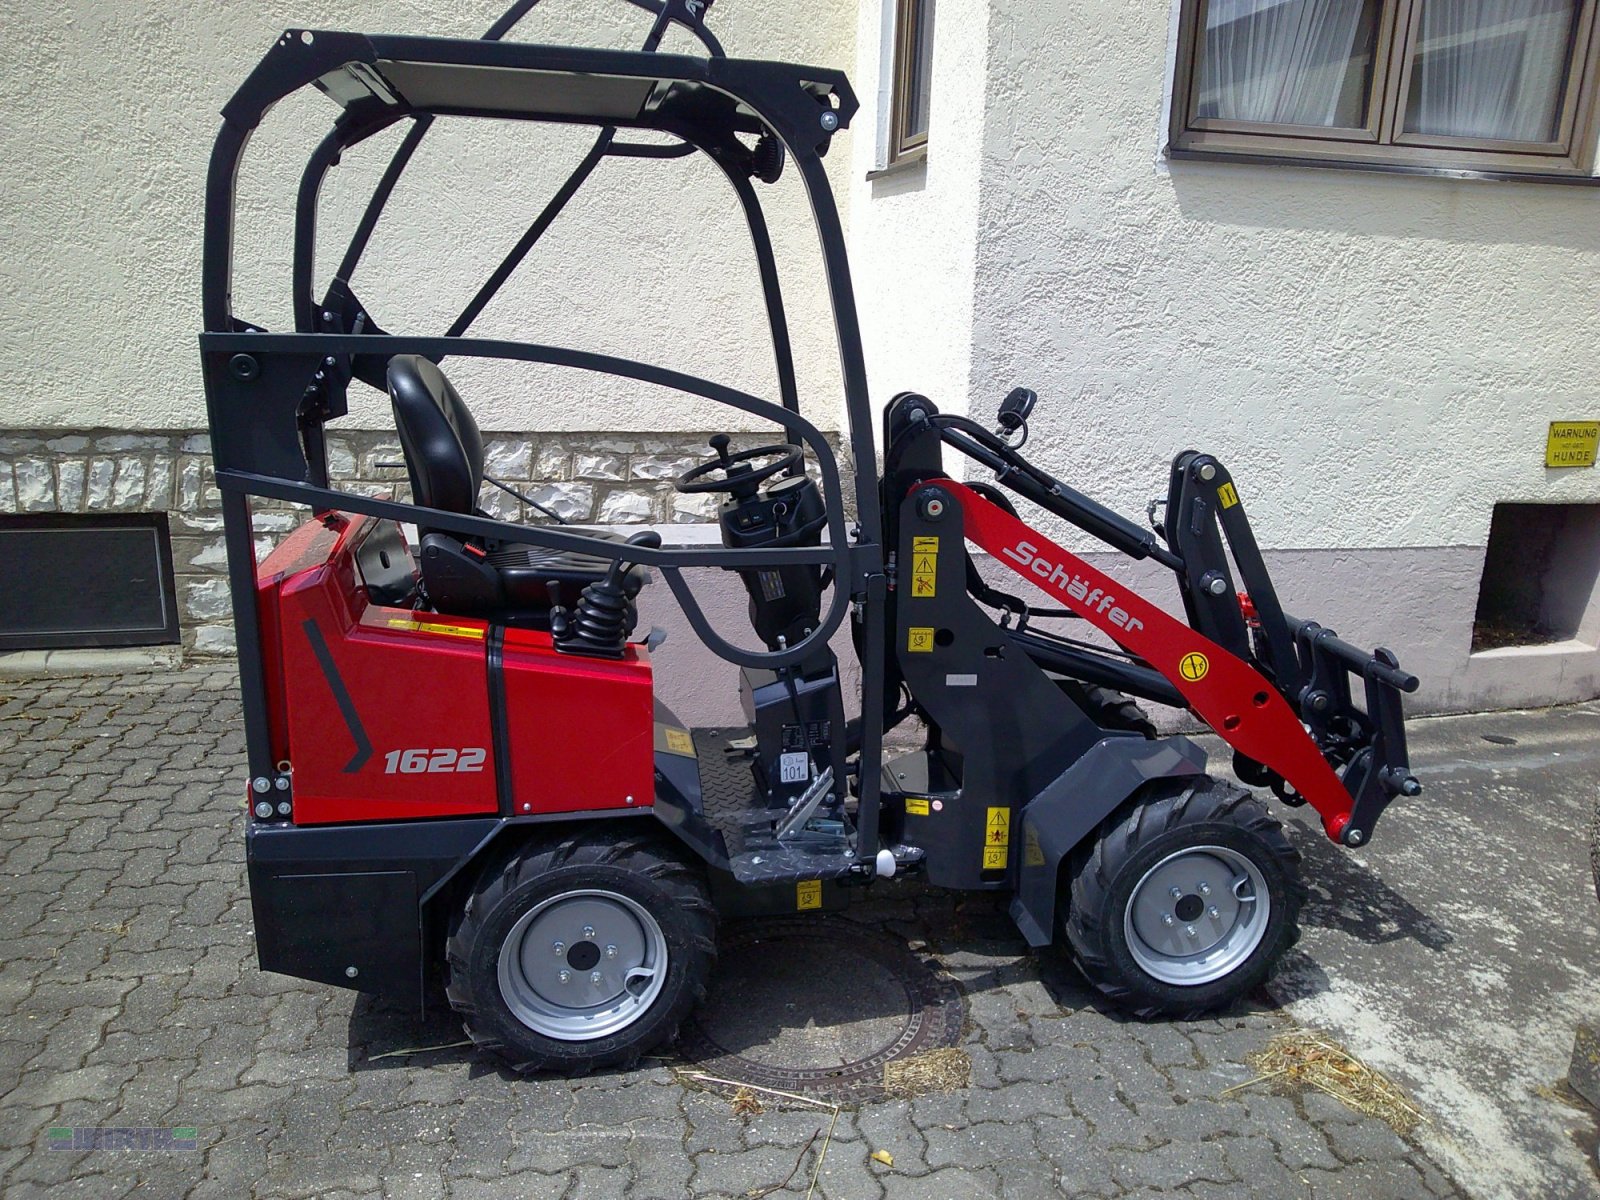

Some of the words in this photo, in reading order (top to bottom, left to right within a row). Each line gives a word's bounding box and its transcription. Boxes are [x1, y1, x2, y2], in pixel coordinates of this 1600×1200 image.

[1553, 428, 1597, 438] WARNUNG
[1553, 451, 1591, 461] HUNDE
[1002, 541, 1144, 632] Schäffer
[384, 747, 487, 774] 1622
[783, 766, 801, 780] 101
